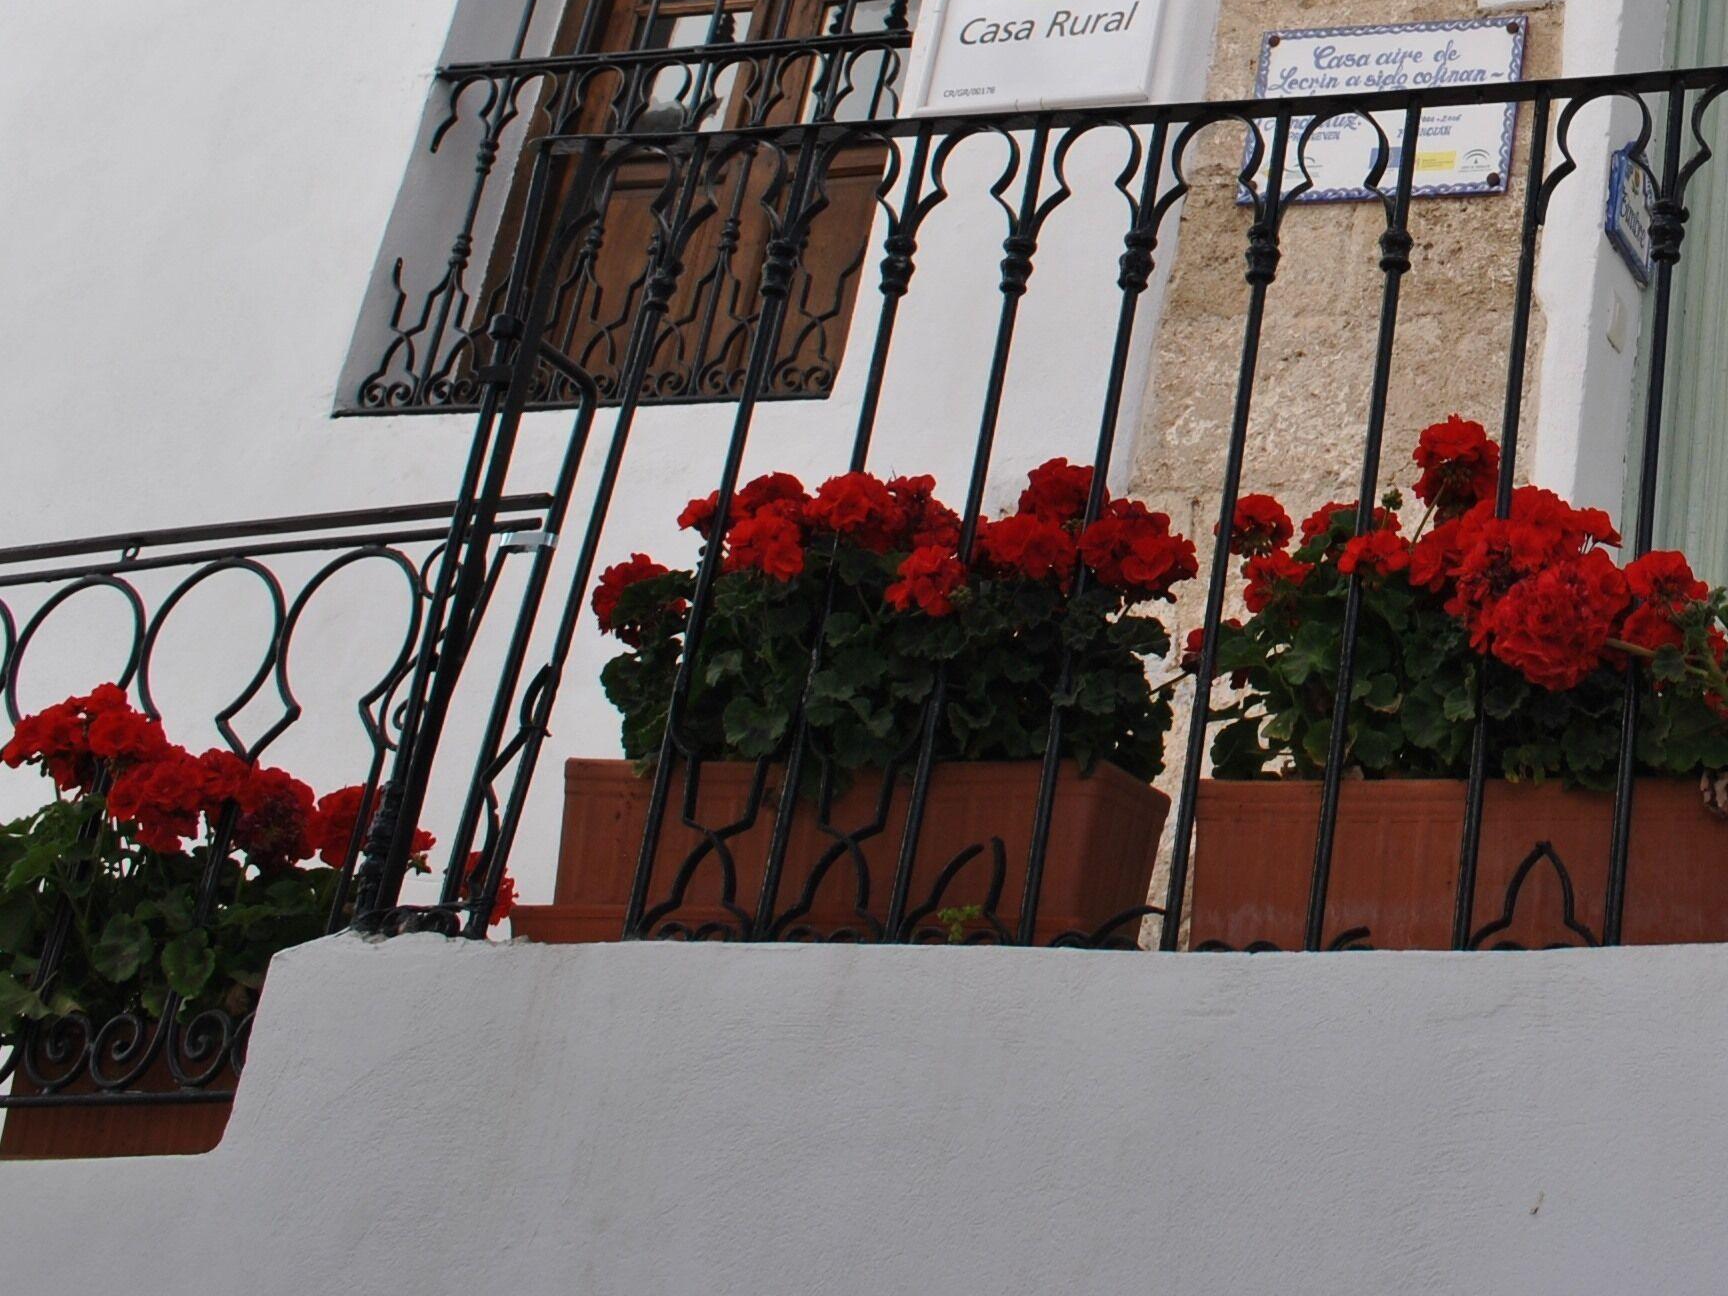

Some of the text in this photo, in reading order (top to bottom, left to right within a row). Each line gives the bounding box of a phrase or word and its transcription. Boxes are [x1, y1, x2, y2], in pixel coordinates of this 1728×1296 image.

[959, 0, 1140, 46] Casa Rural
[1313, 39, 1461, 71] Casa aire de
[1268, 66, 1340, 92] Lecrin
[1345, 75, 1362, 89] a
[1364, 63, 1406, 87] sido
